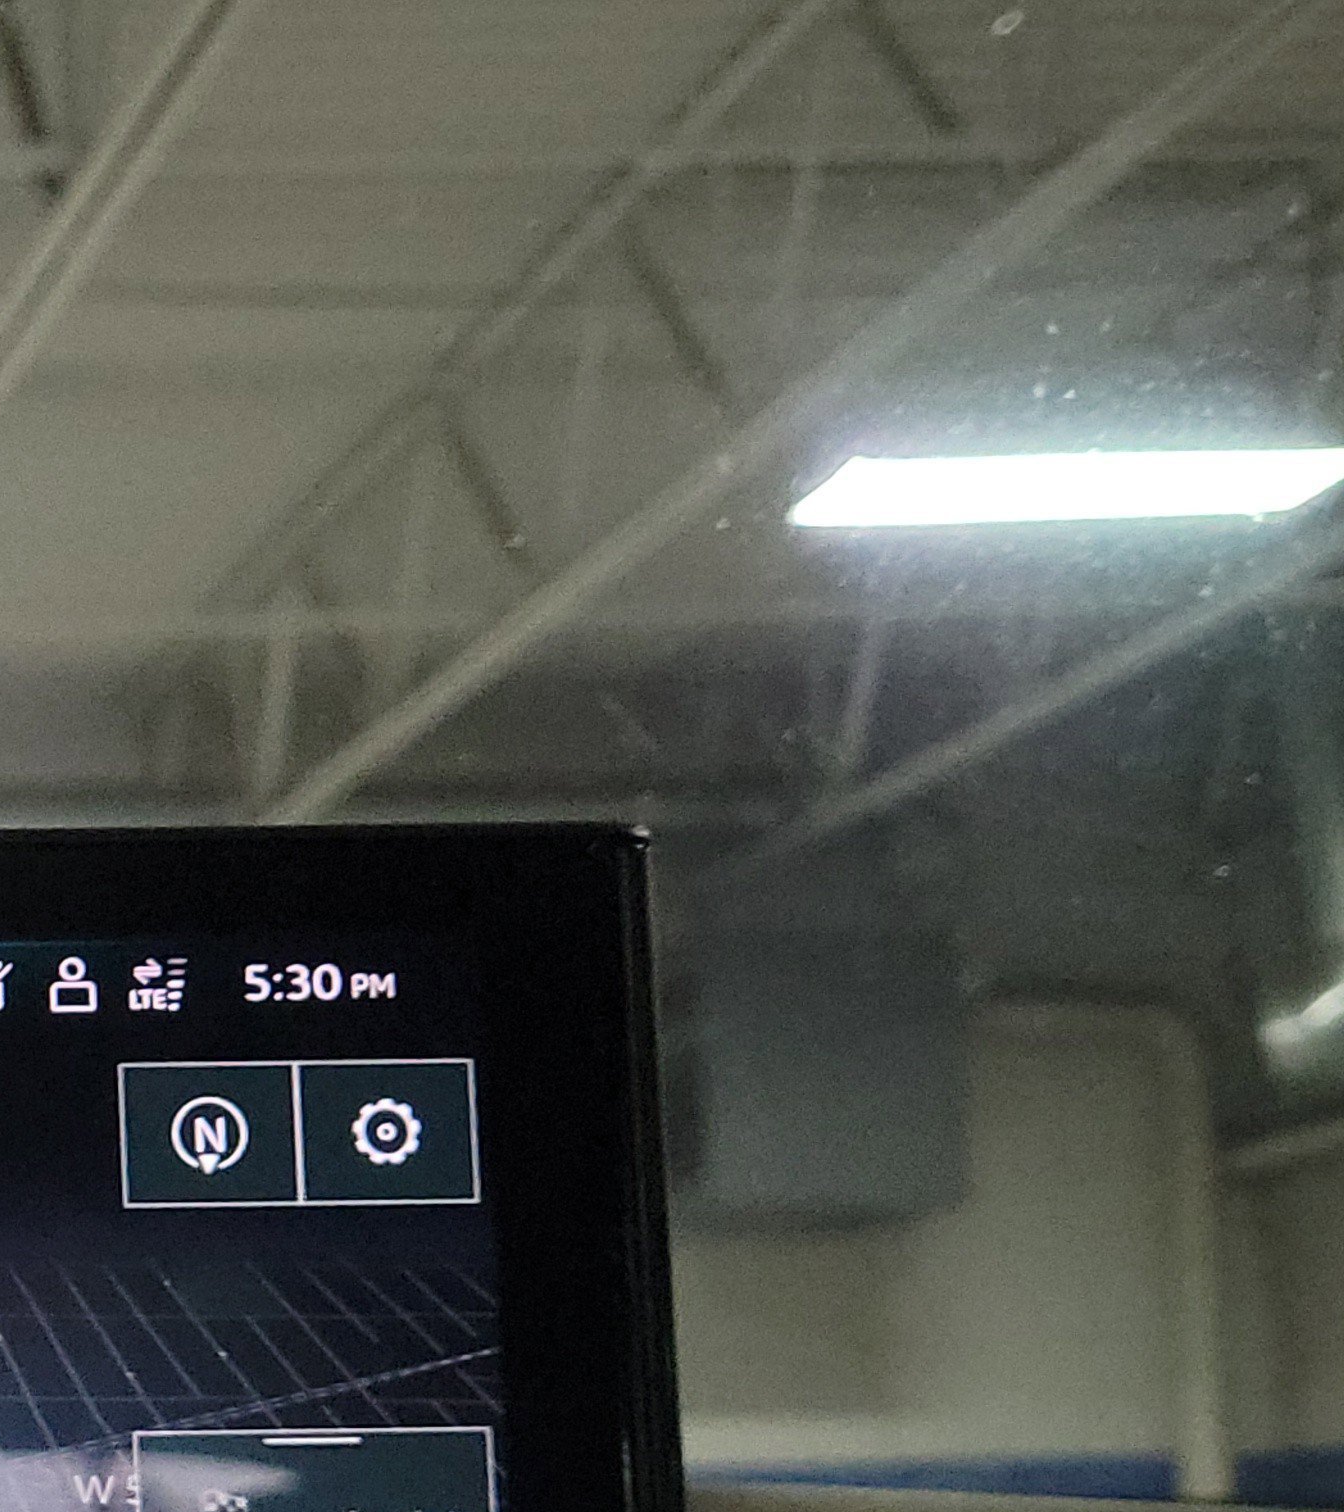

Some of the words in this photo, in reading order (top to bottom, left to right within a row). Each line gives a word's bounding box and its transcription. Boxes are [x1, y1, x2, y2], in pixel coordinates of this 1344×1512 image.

[128, 988, 168, 1011] LTE
[244, 963, 343, 1002] 5:30
[350, 973, 397, 999] PM
[193, 1115, 228, 1154] N
[73, 1474, 114, 1504] W
